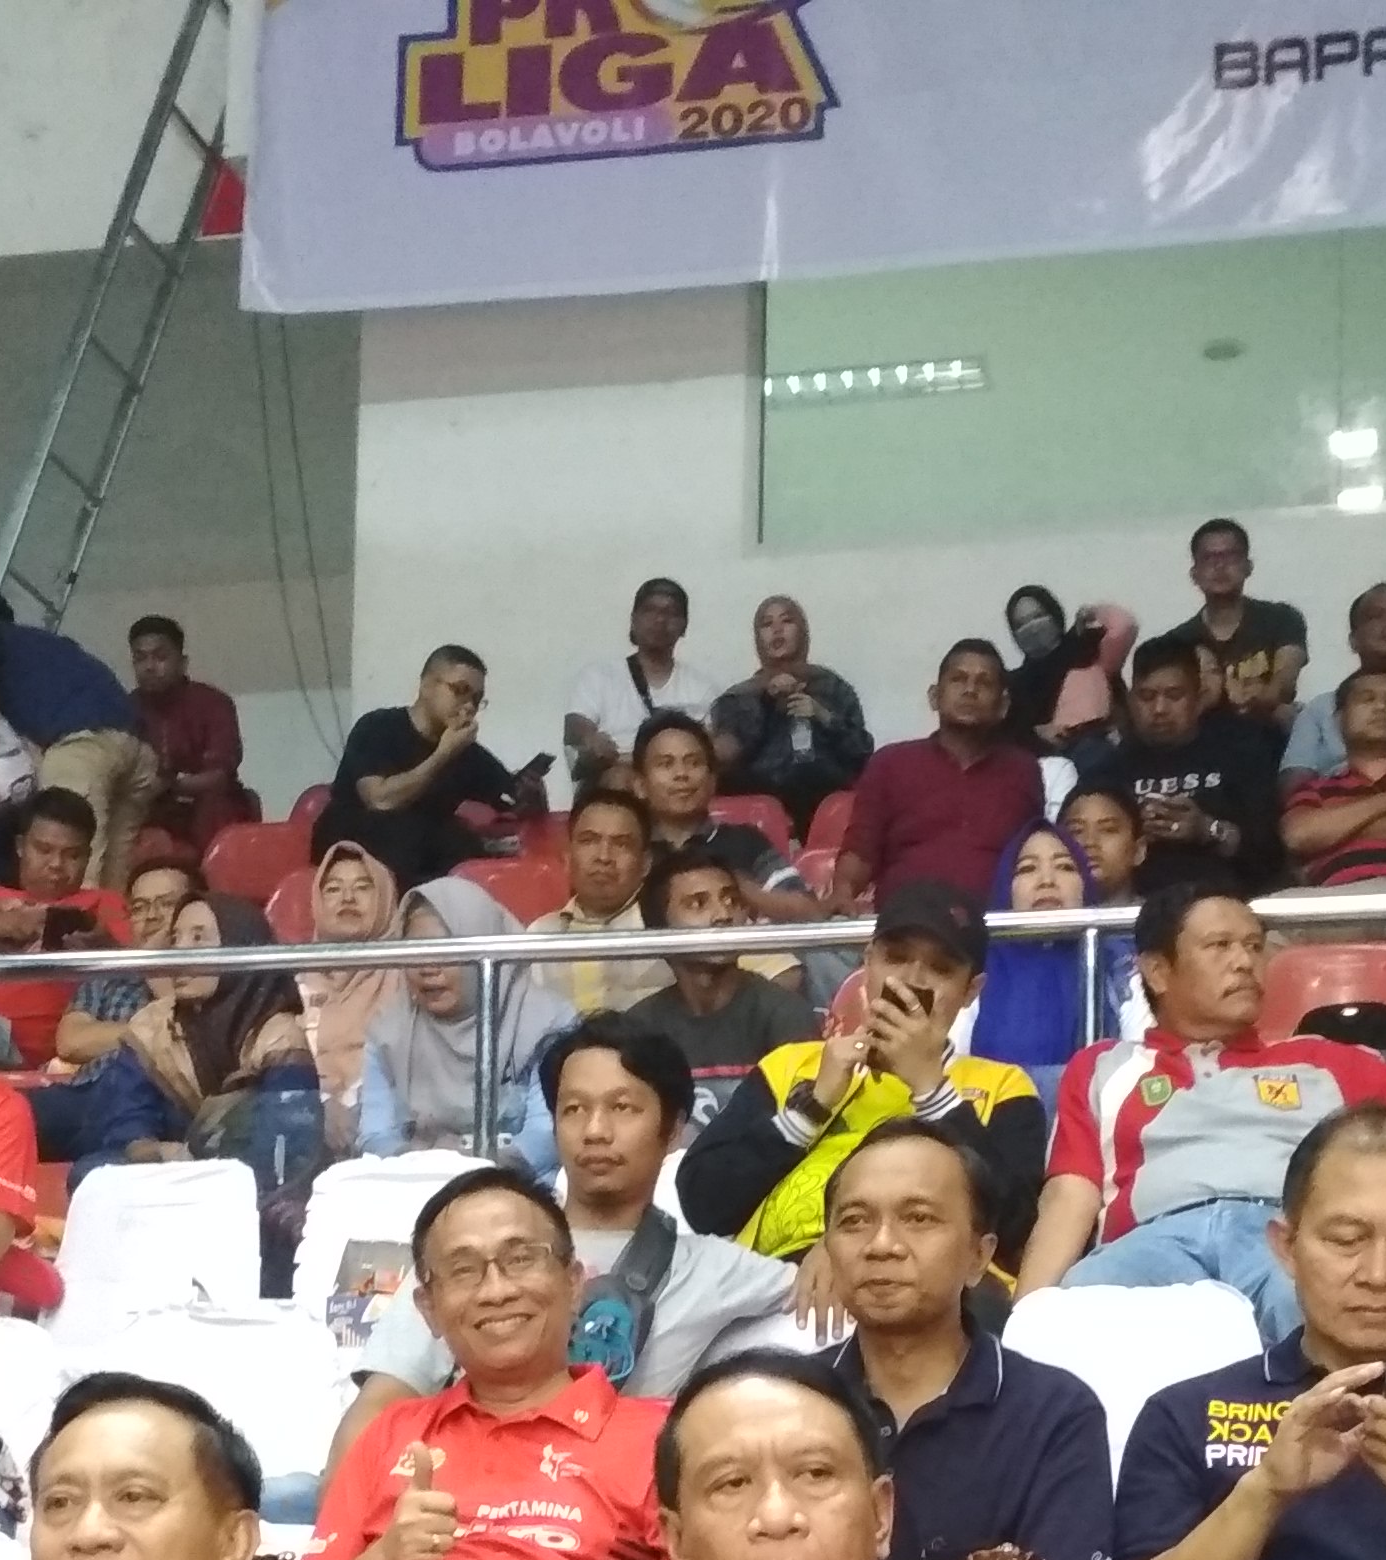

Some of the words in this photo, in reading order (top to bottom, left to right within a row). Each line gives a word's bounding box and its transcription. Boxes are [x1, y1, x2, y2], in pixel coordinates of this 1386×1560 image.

[418, 19, 803, 125] LIGA
[453, 115, 646, 157] BOLAVOLI
[677, 96, 811, 139] 2020
[476, 1500, 583, 1524] PERTAMINA
